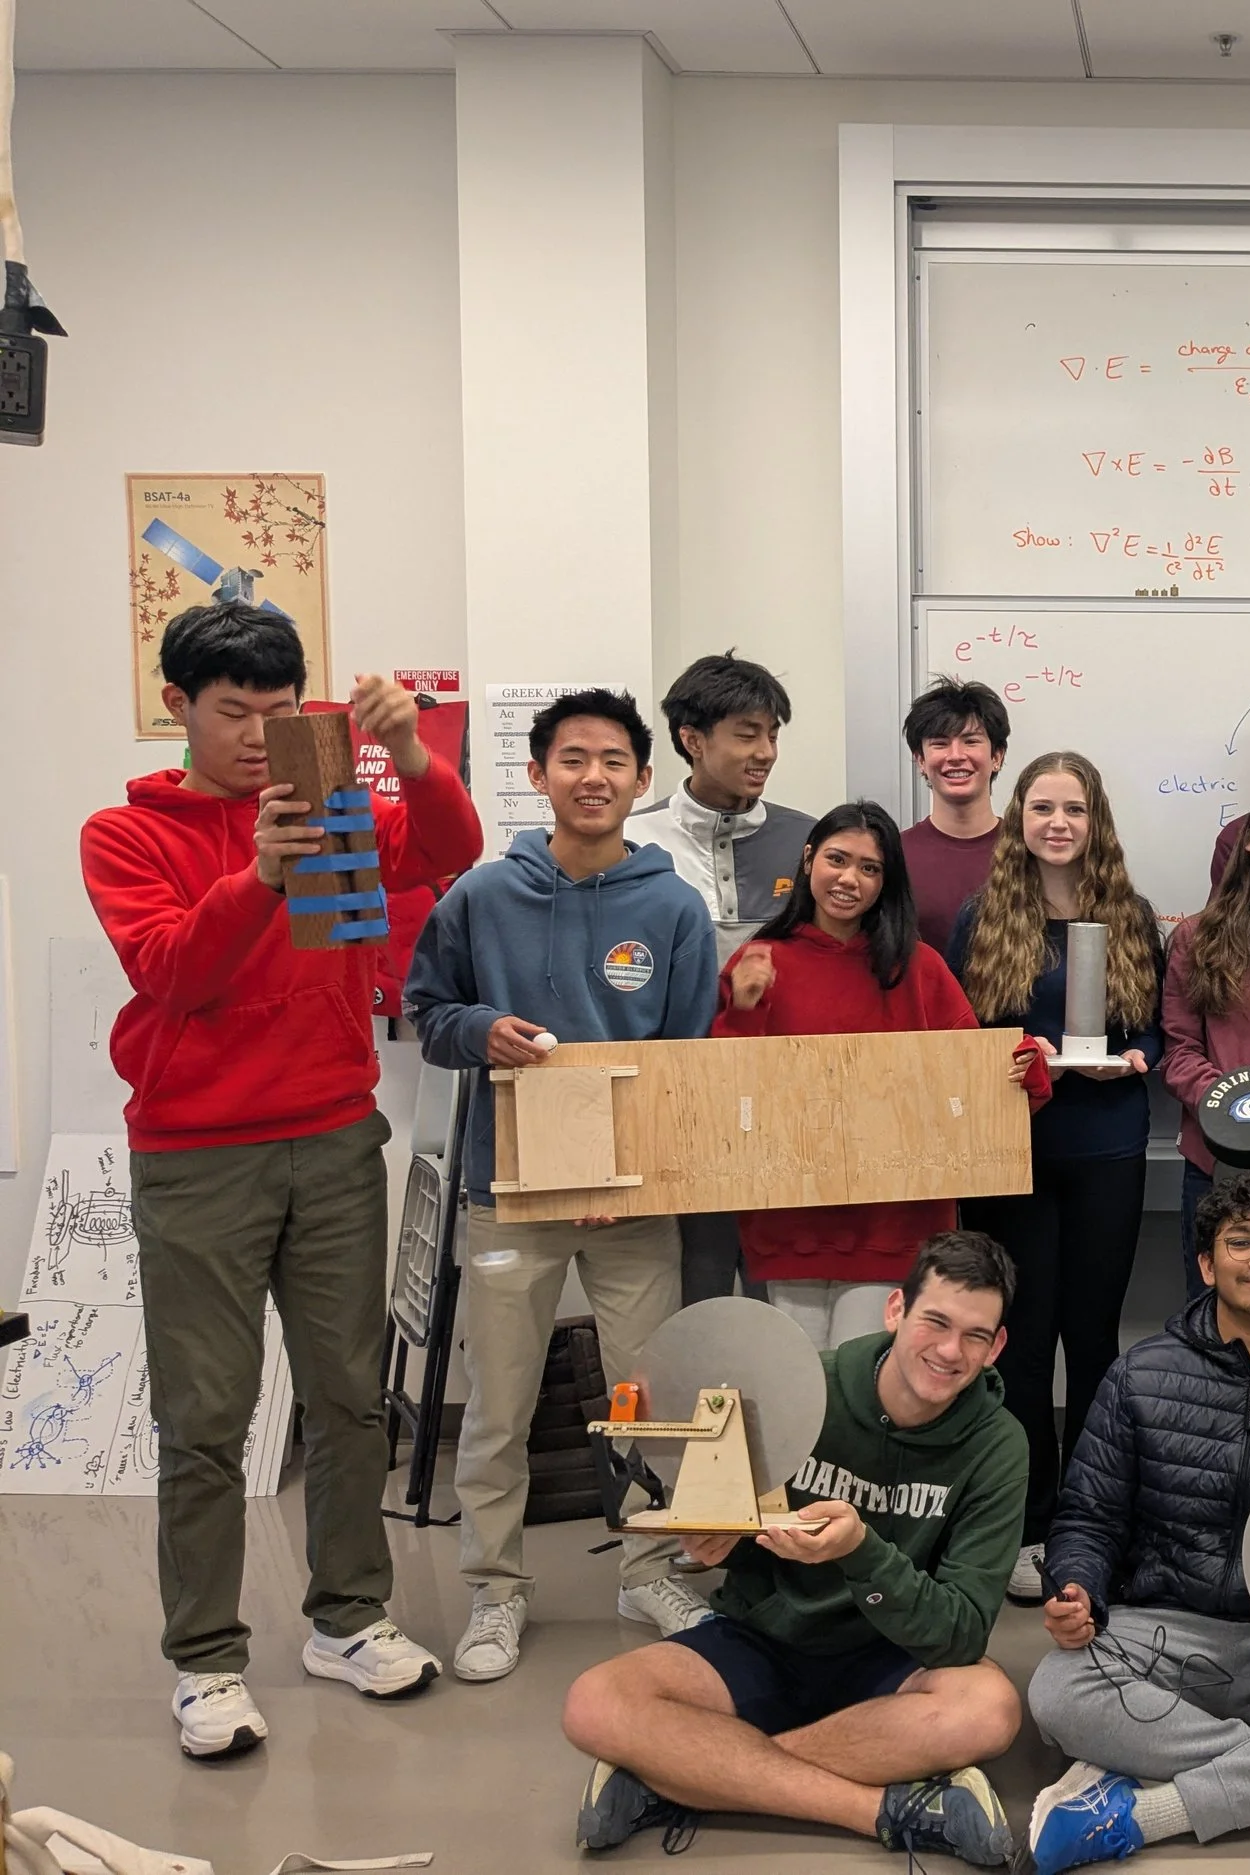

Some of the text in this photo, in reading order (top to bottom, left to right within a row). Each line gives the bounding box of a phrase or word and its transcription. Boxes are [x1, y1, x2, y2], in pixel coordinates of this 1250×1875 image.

[1178, 342, 1236, 364] charge
[143, 491, 191, 502] BSAT-4a
[396, 670, 458, 681] EMERGENCY USE
[414, 680, 439, 692] ONLY
[502, 688, 544, 699] GREEK
[359, 744, 391, 759] FIRE
[355, 761, 387, 775] AND
[376, 776, 401, 792] AID
[1158, 775, 1239, 794] electric
[792, 1455, 954, 1519] DARTMOUT
